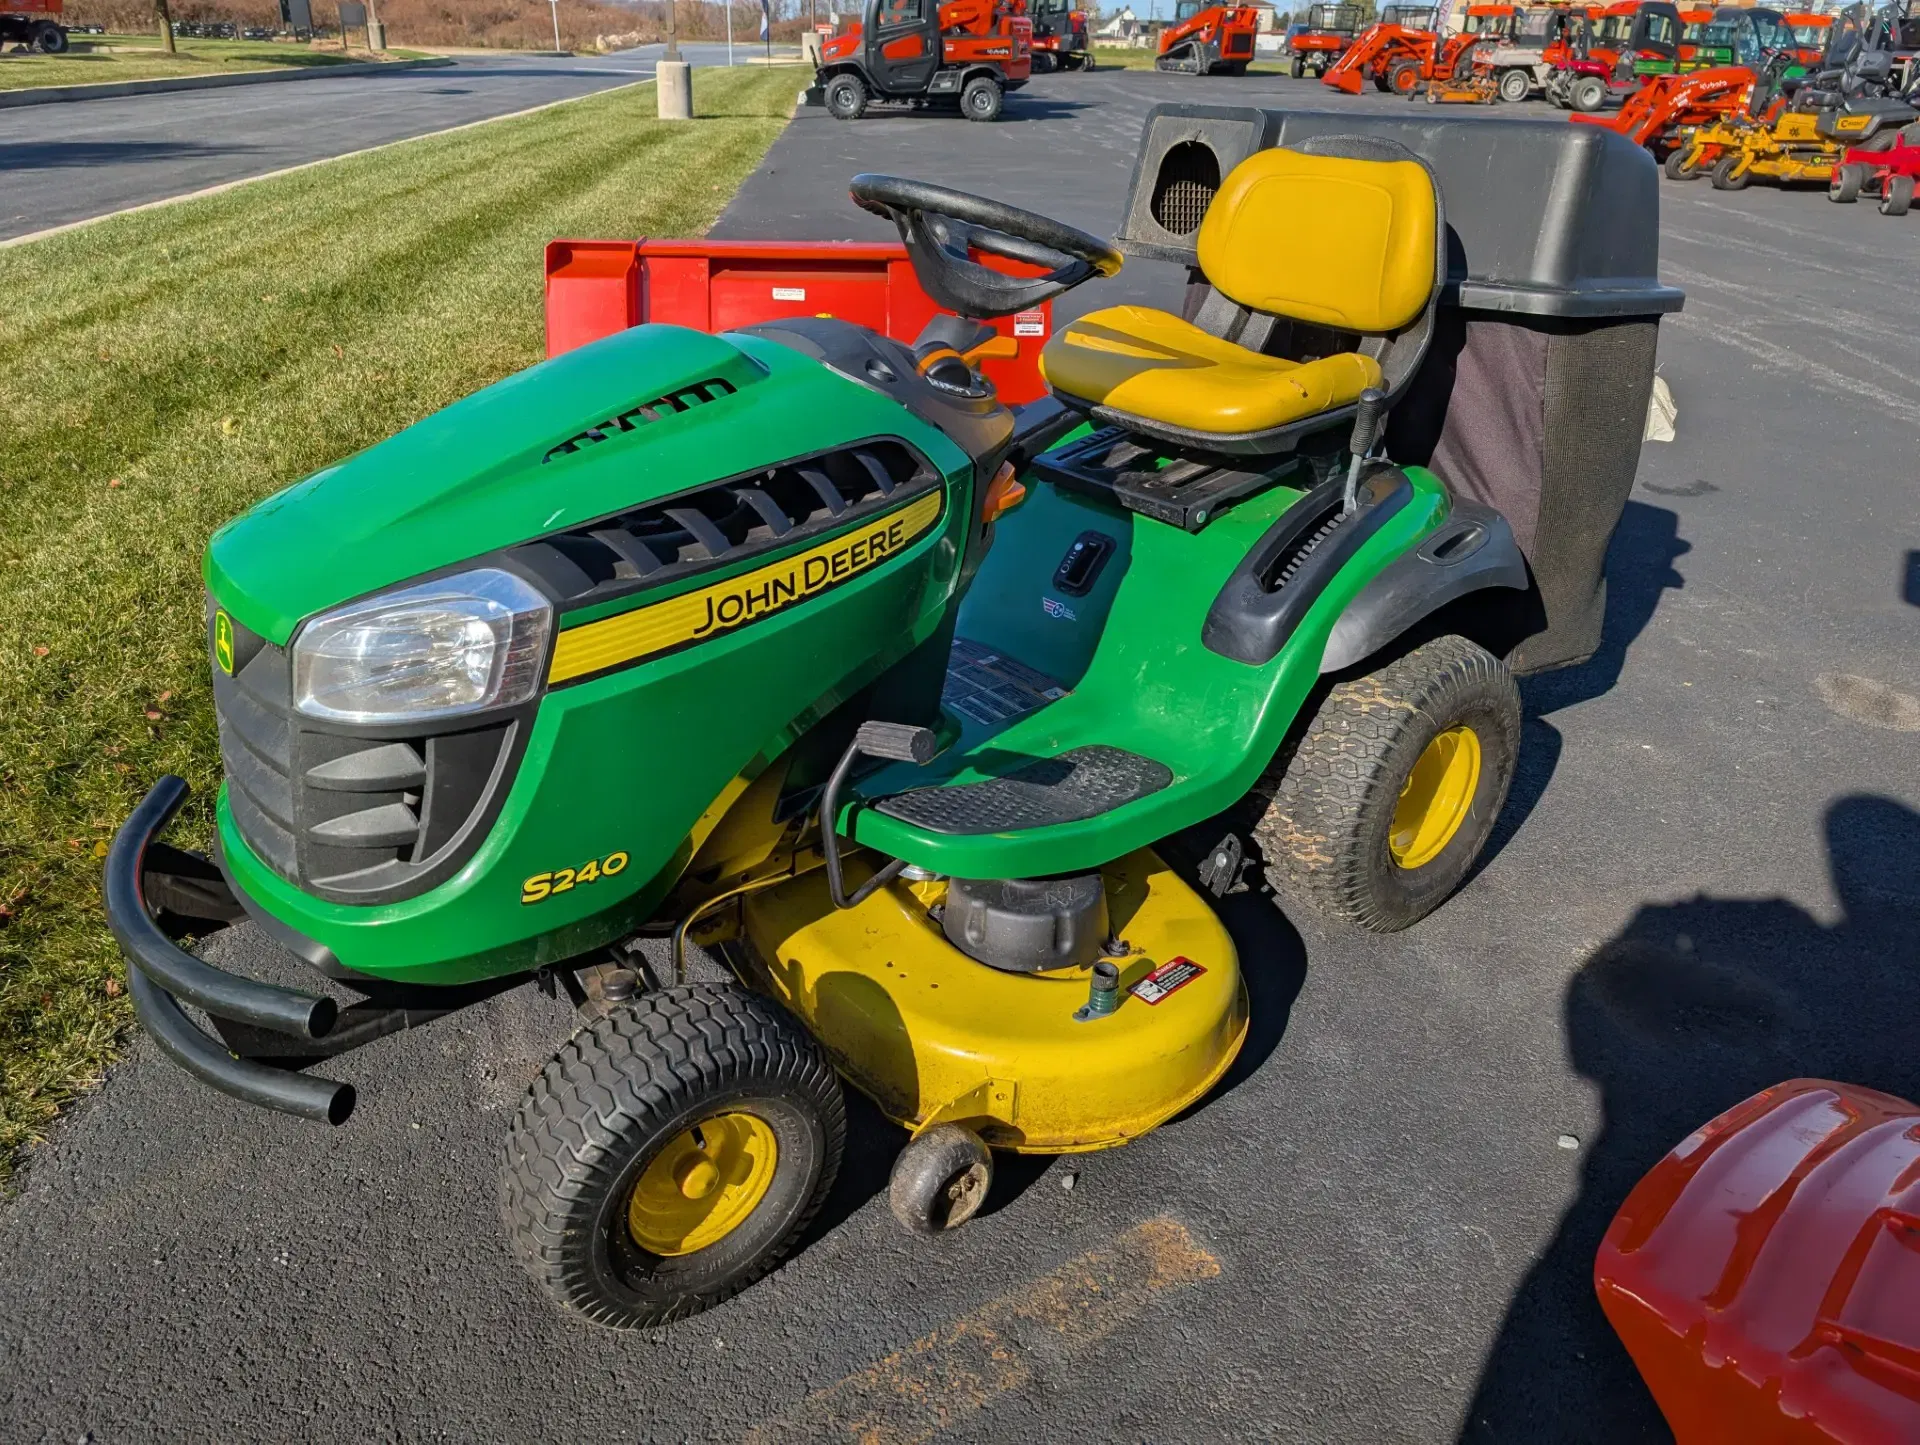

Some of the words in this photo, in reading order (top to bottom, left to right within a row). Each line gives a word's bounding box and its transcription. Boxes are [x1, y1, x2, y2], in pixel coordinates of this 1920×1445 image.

[1700, 80, 1727, 90] Kubota
[693, 571, 796, 636] JOHN
[803, 518, 905, 591] DEERE
[521, 851, 629, 904] S240
